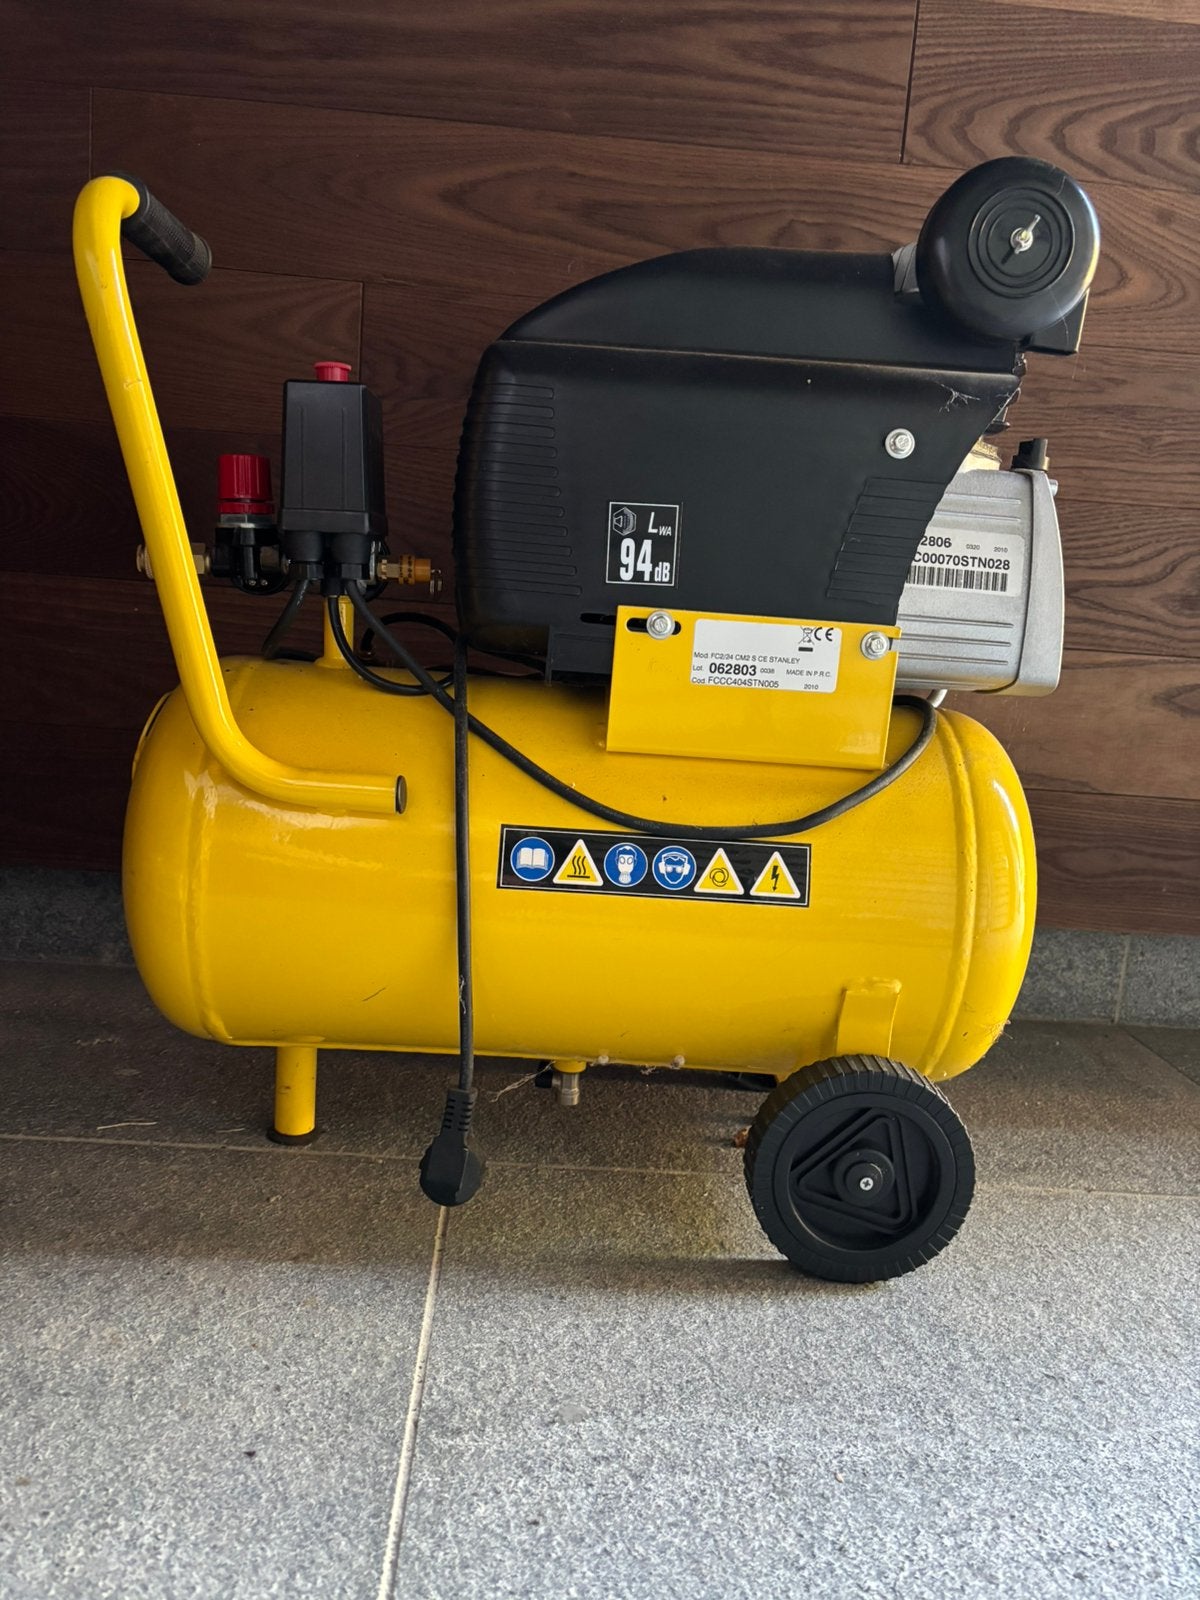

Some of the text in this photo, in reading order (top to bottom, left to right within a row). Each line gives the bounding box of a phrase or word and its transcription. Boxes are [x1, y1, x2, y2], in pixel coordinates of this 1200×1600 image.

[993, 546, 1008, 554] 2010
[914, 551, 1010, 570] C00070STN028
[757, 655, 768, 663] CE
[769, 655, 801, 665] STANLEY
[709, 662, 757, 676] 062803
[708, 676, 779, 688] FCCC404STN005
